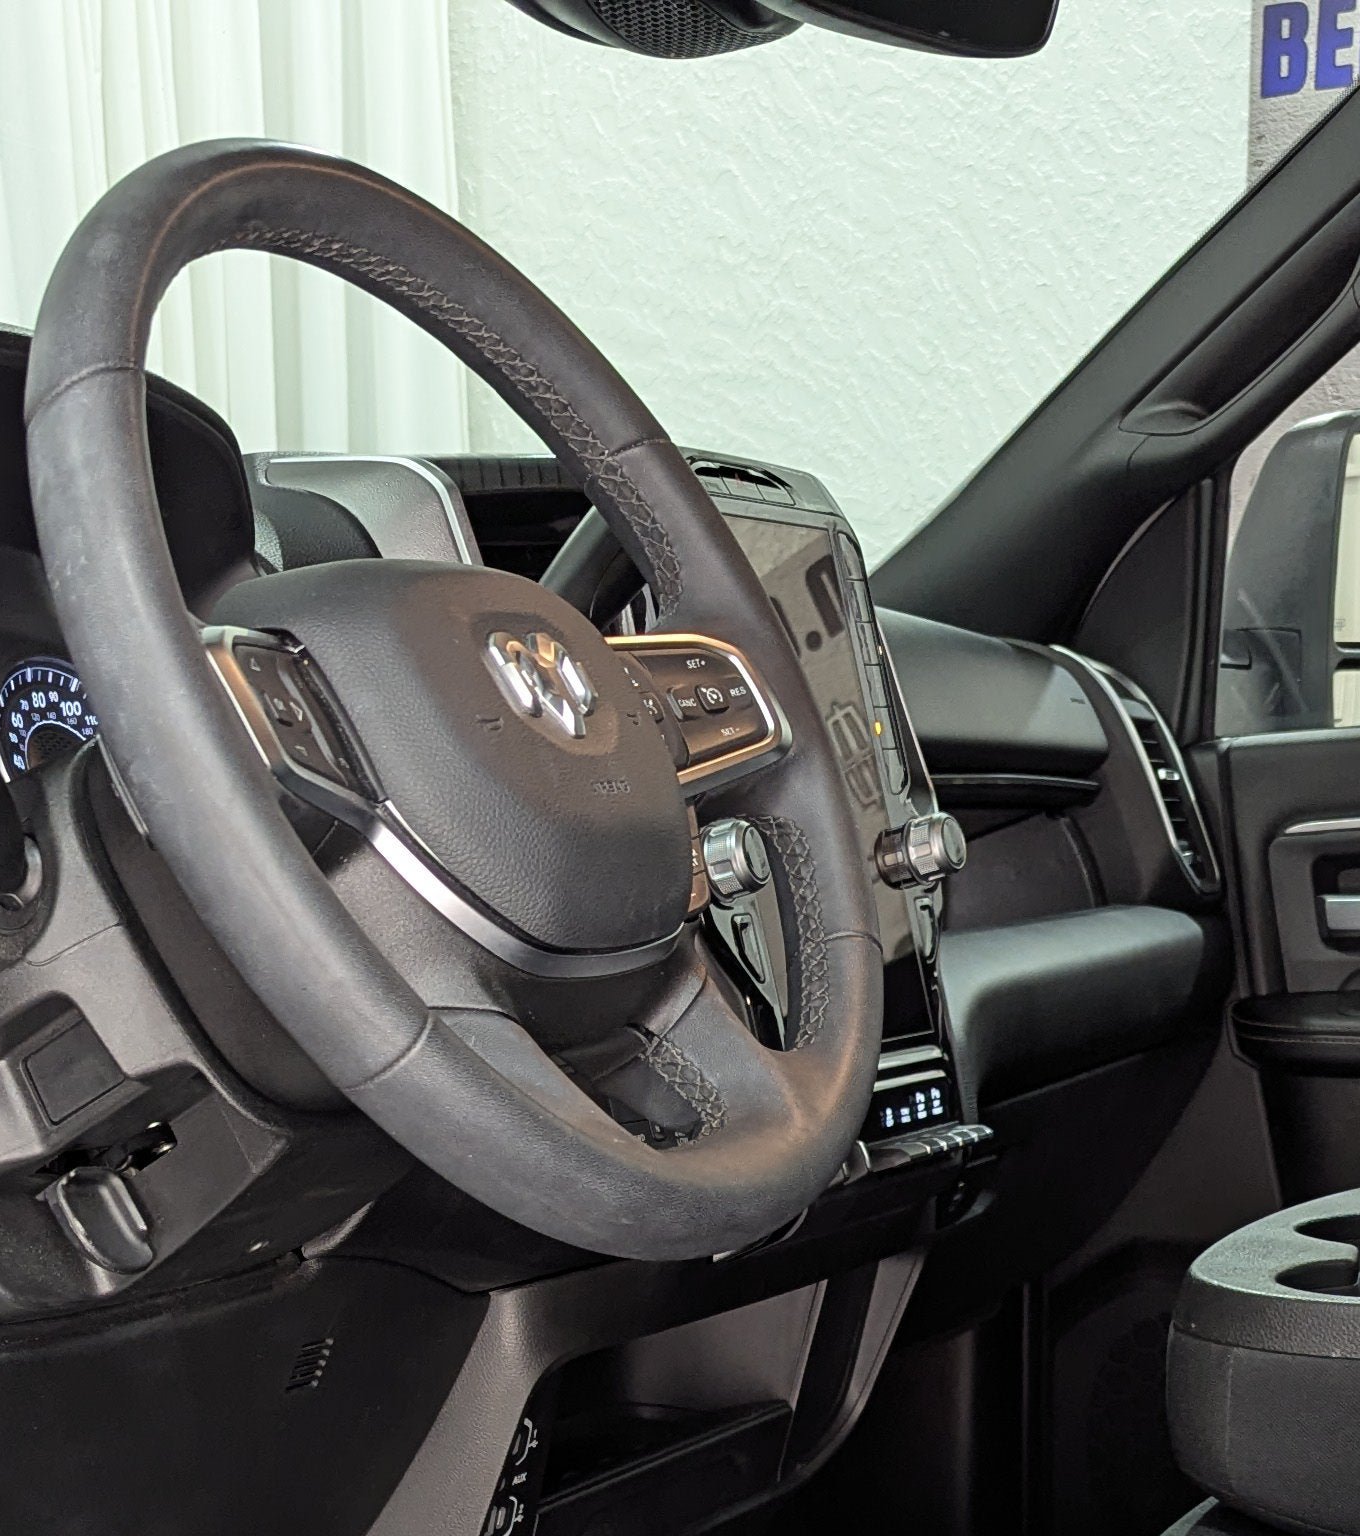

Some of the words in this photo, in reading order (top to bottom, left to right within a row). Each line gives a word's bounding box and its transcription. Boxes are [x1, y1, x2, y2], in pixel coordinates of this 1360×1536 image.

[31, 691, 47, 708] 80
[729, 686, 747, 697] RES
[59, 701, 82, 717] 100
[11, 711, 24, 729] 60
